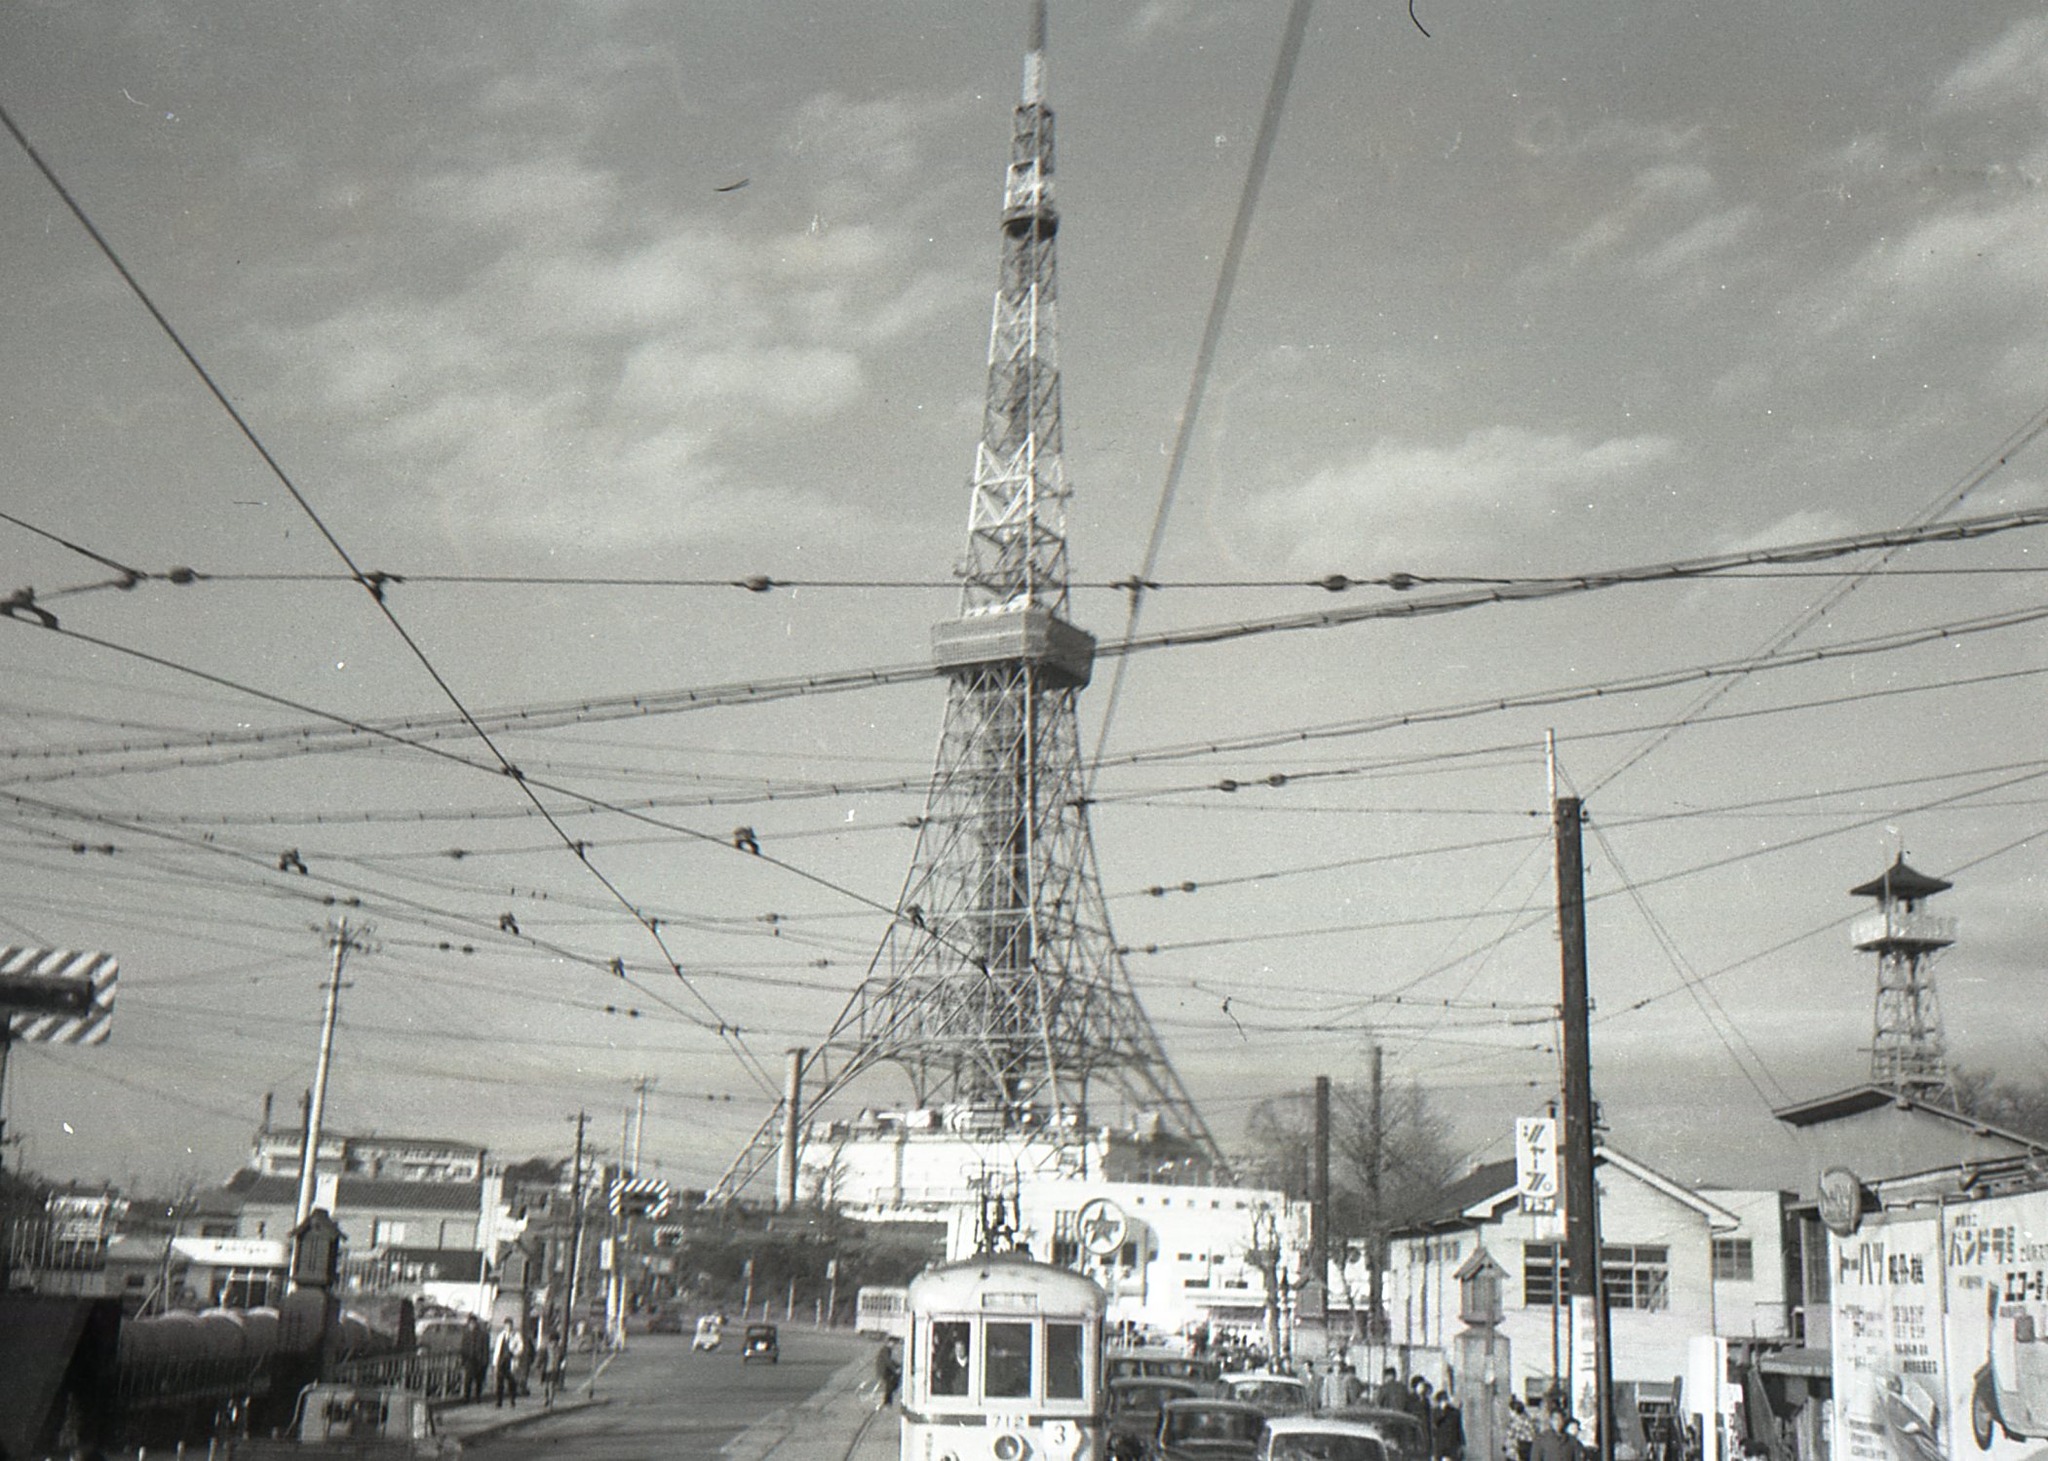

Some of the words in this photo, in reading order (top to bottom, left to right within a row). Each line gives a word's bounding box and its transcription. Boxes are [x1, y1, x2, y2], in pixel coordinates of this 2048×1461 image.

[1523, 1124, 1553, 1191] シャープ
[1838, 1241, 1884, 1285] トーハツ
[1054, 1425, 1066, 1445] 3
